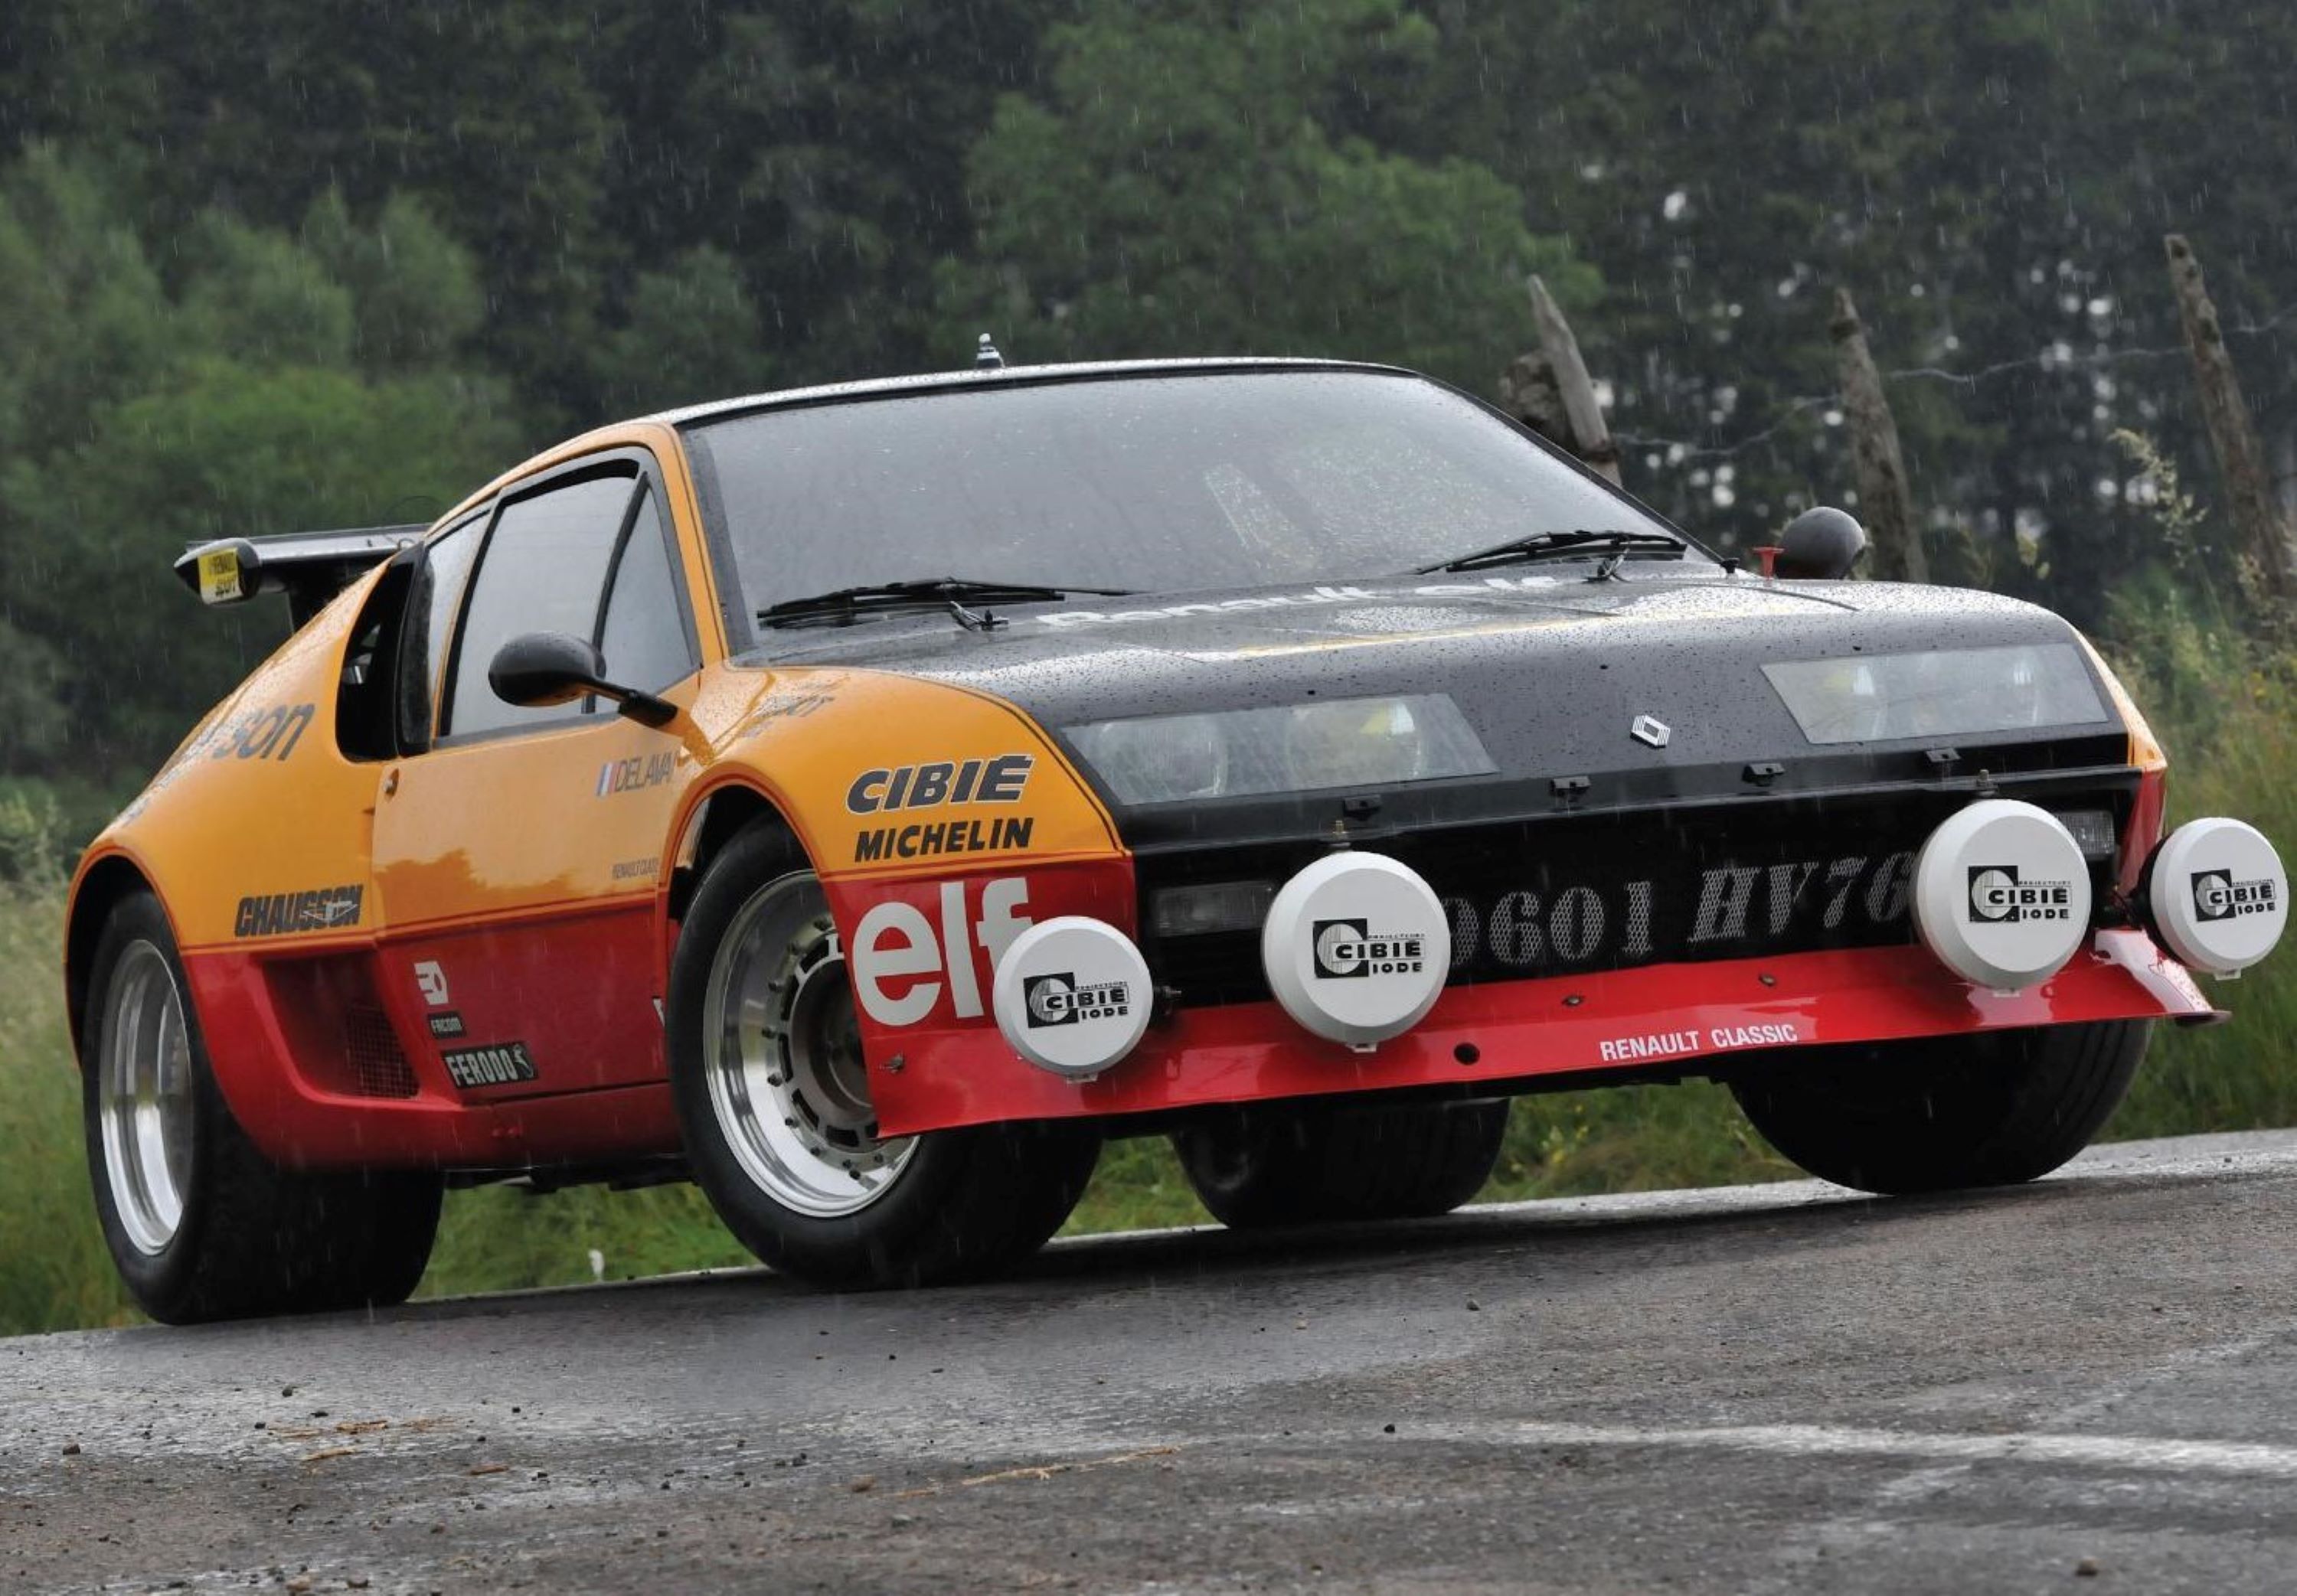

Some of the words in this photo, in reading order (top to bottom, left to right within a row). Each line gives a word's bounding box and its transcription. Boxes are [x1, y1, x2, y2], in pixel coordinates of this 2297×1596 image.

[613, 751, 679, 792] DELAVA
[854, 817, 1034, 863] MICHELIN
[2022, 909, 2070, 919] IODE
[2237, 902, 2276, 915] IODE
[851, 876, 1033, 1026] elf
[1373, 961, 1423, 974] IODE
[1082, 1006, 1128, 1020] IODE
[1599, 1030, 1699, 1062] RENAULT
[1711, 1024, 1799, 1049] CLASSIC
[445, 1049, 518, 1087] FERODO
